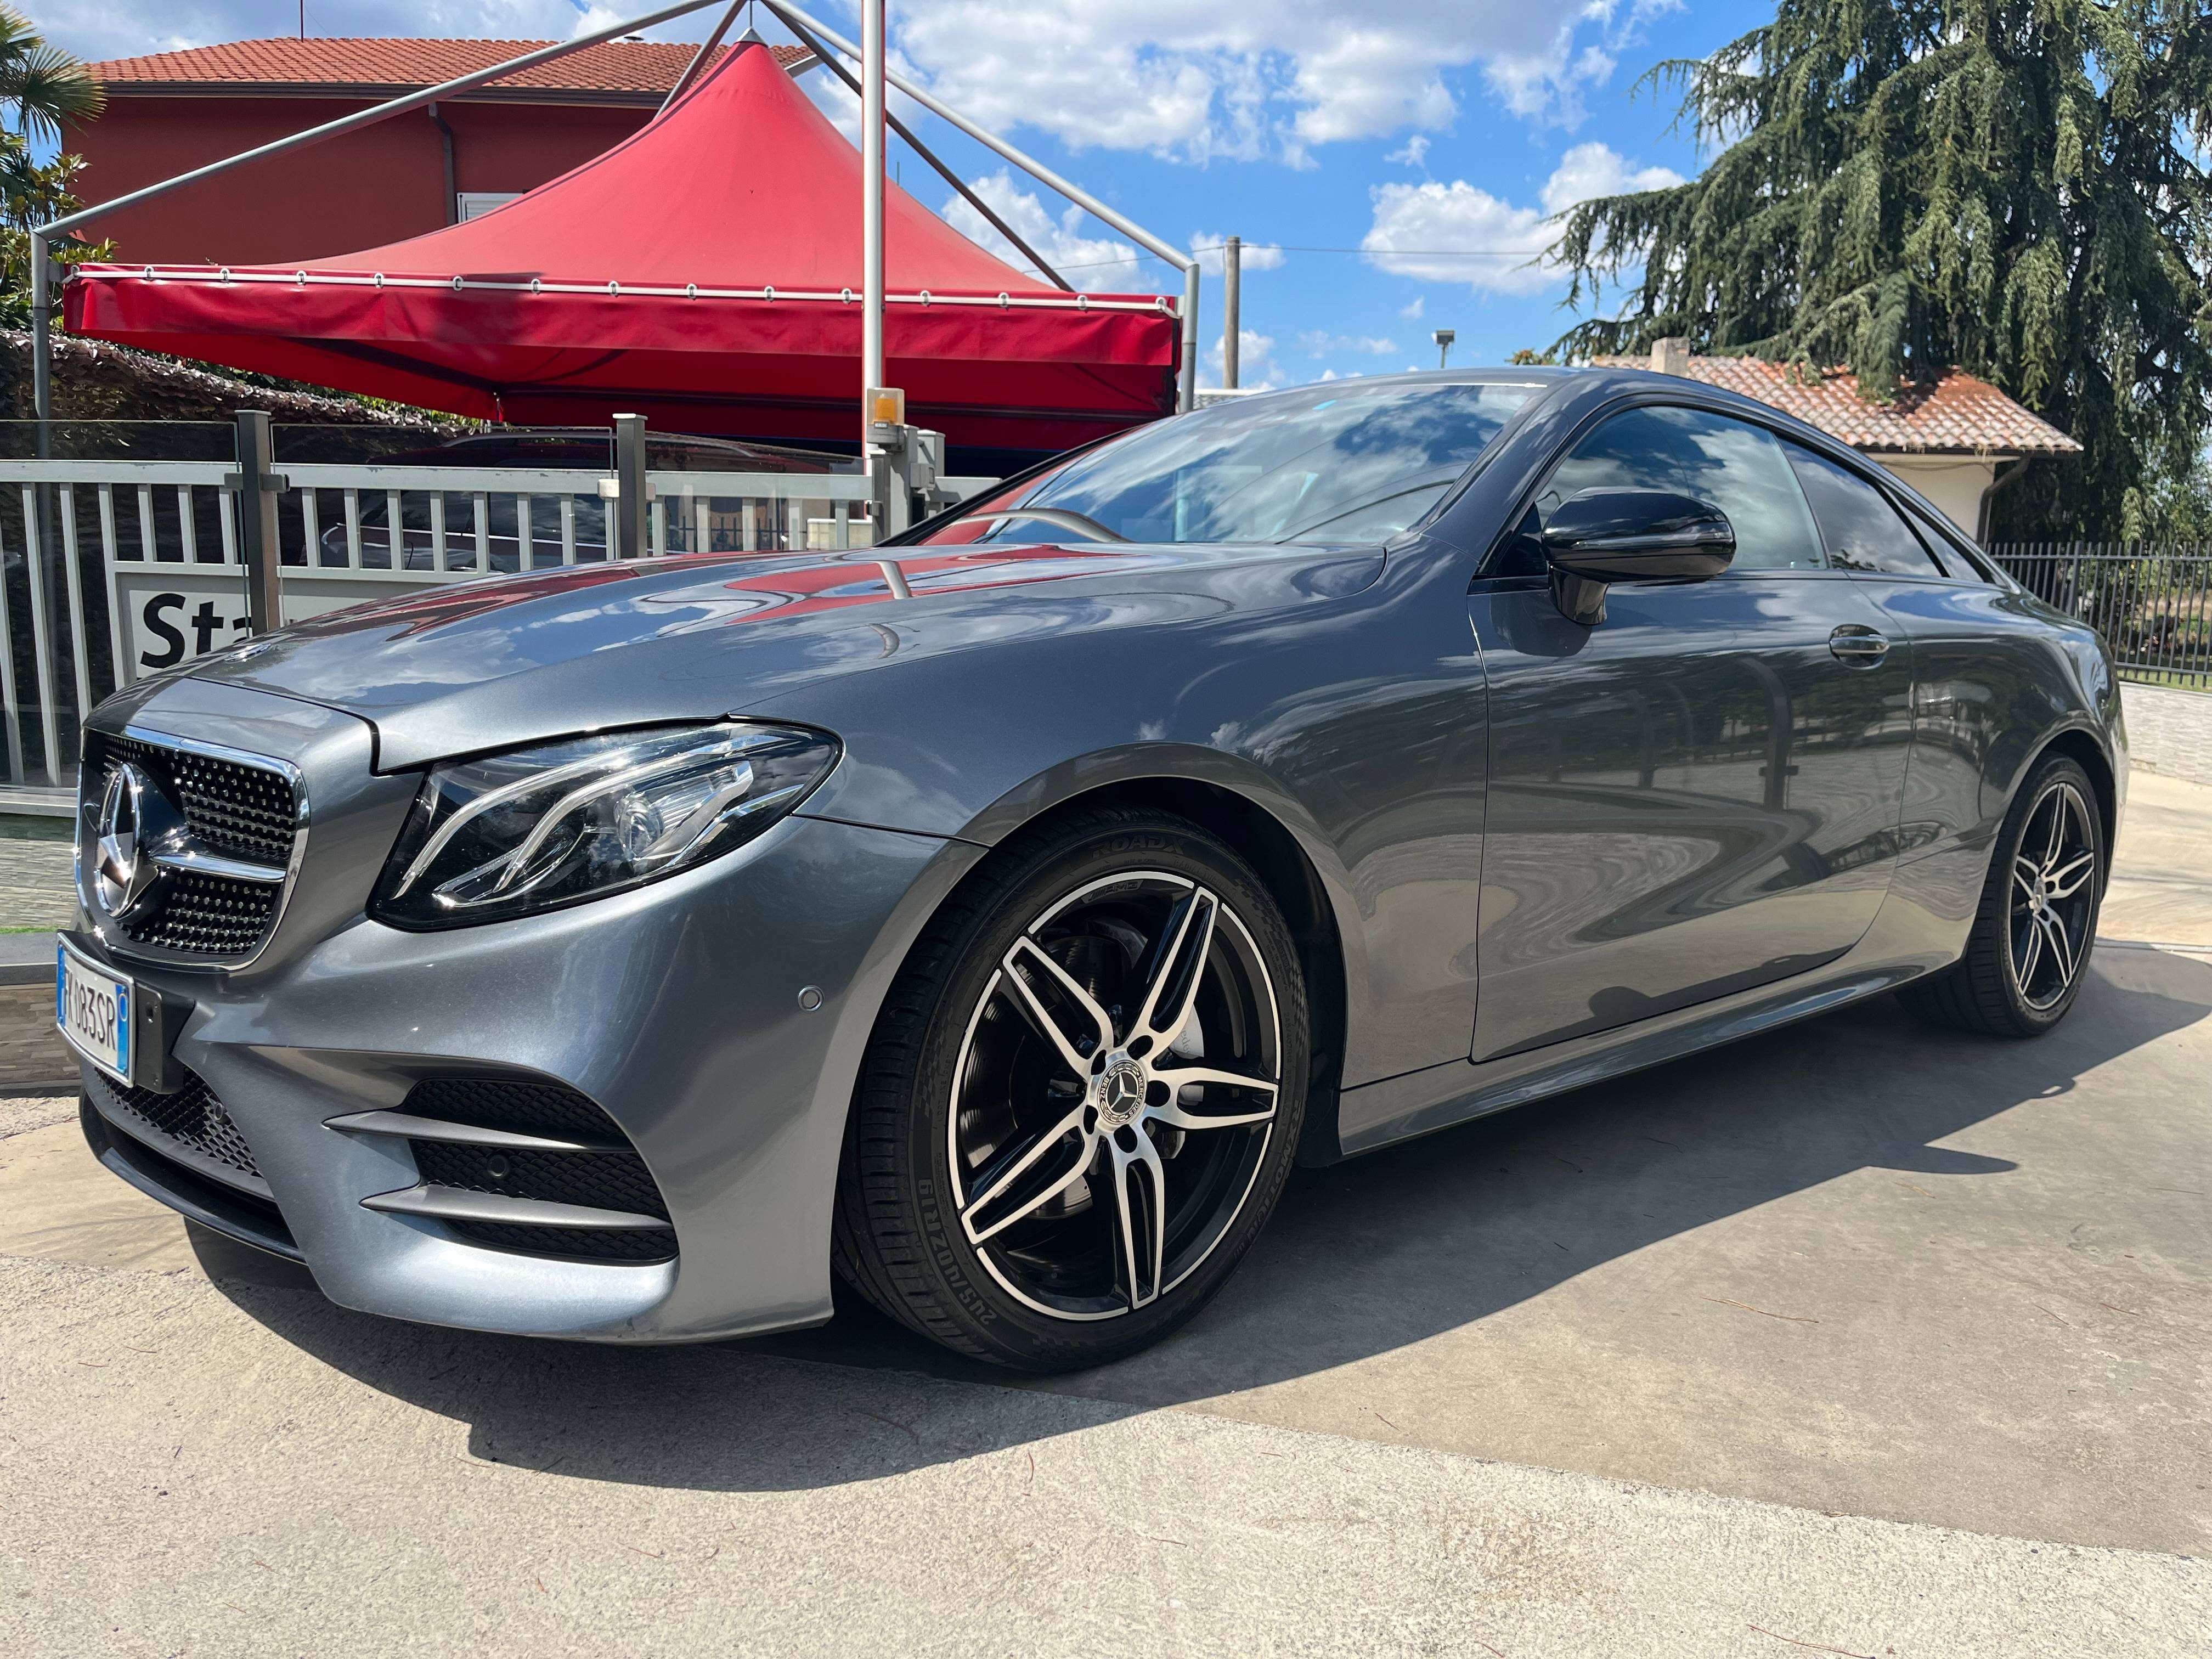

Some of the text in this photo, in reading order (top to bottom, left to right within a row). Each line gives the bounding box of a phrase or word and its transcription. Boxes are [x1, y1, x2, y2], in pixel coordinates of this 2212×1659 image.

[1091, 834, 1186, 859] ROADX
[1099, 1076, 1110, 1099] BENZ
[1128, 1075, 1144, 1117] MERCEDES
[917, 1178, 998, 1325] 245/40ZR19
